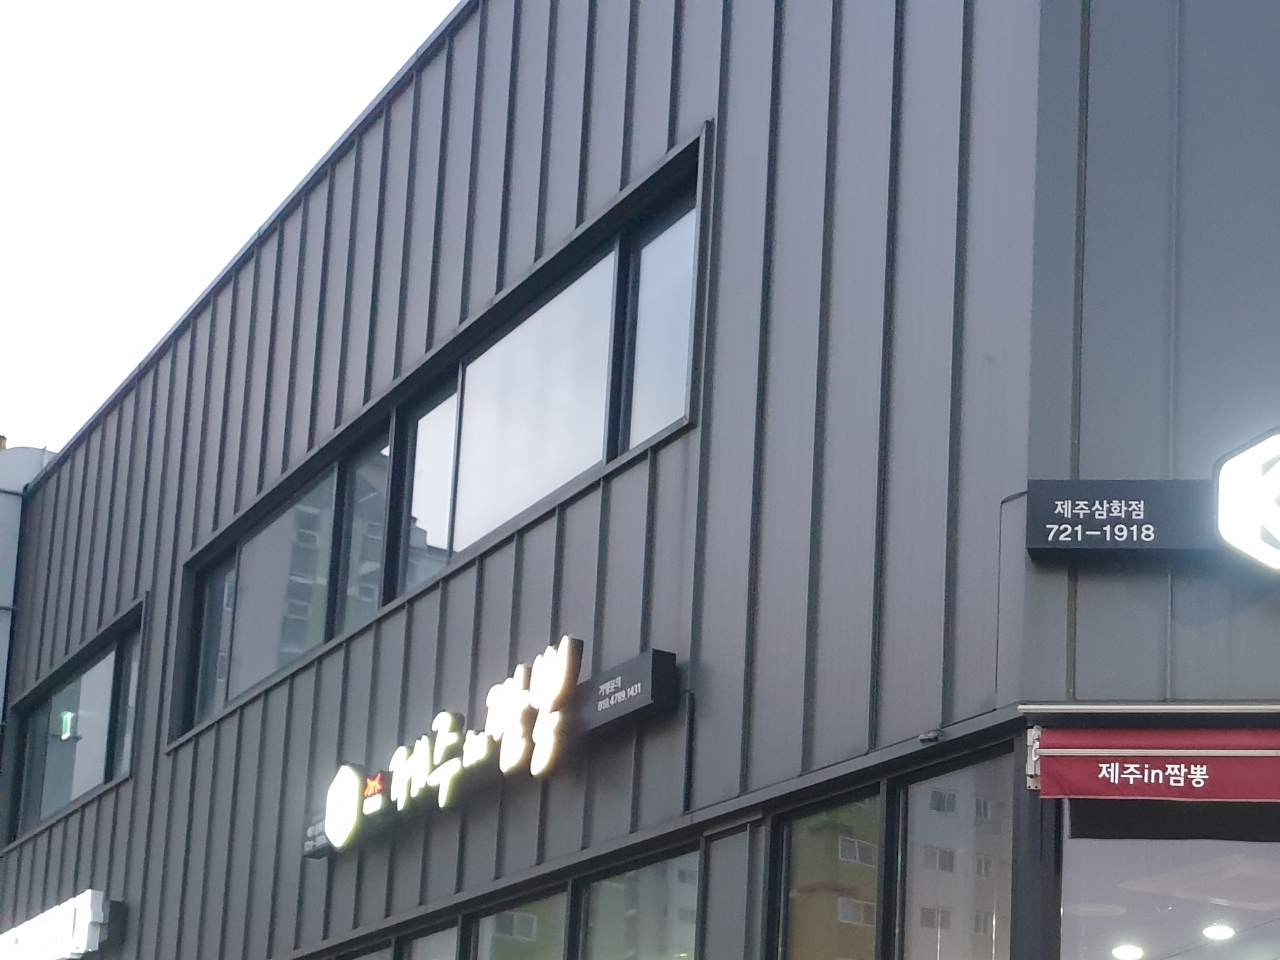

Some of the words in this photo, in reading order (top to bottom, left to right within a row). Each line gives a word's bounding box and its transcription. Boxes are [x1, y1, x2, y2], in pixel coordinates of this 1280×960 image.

[1054, 499, 1145, 519] 제주삼화점
[1045, 524, 1155, 541] 721-1918
[1097, 761, 1210, 788] 제주in짬뽕
